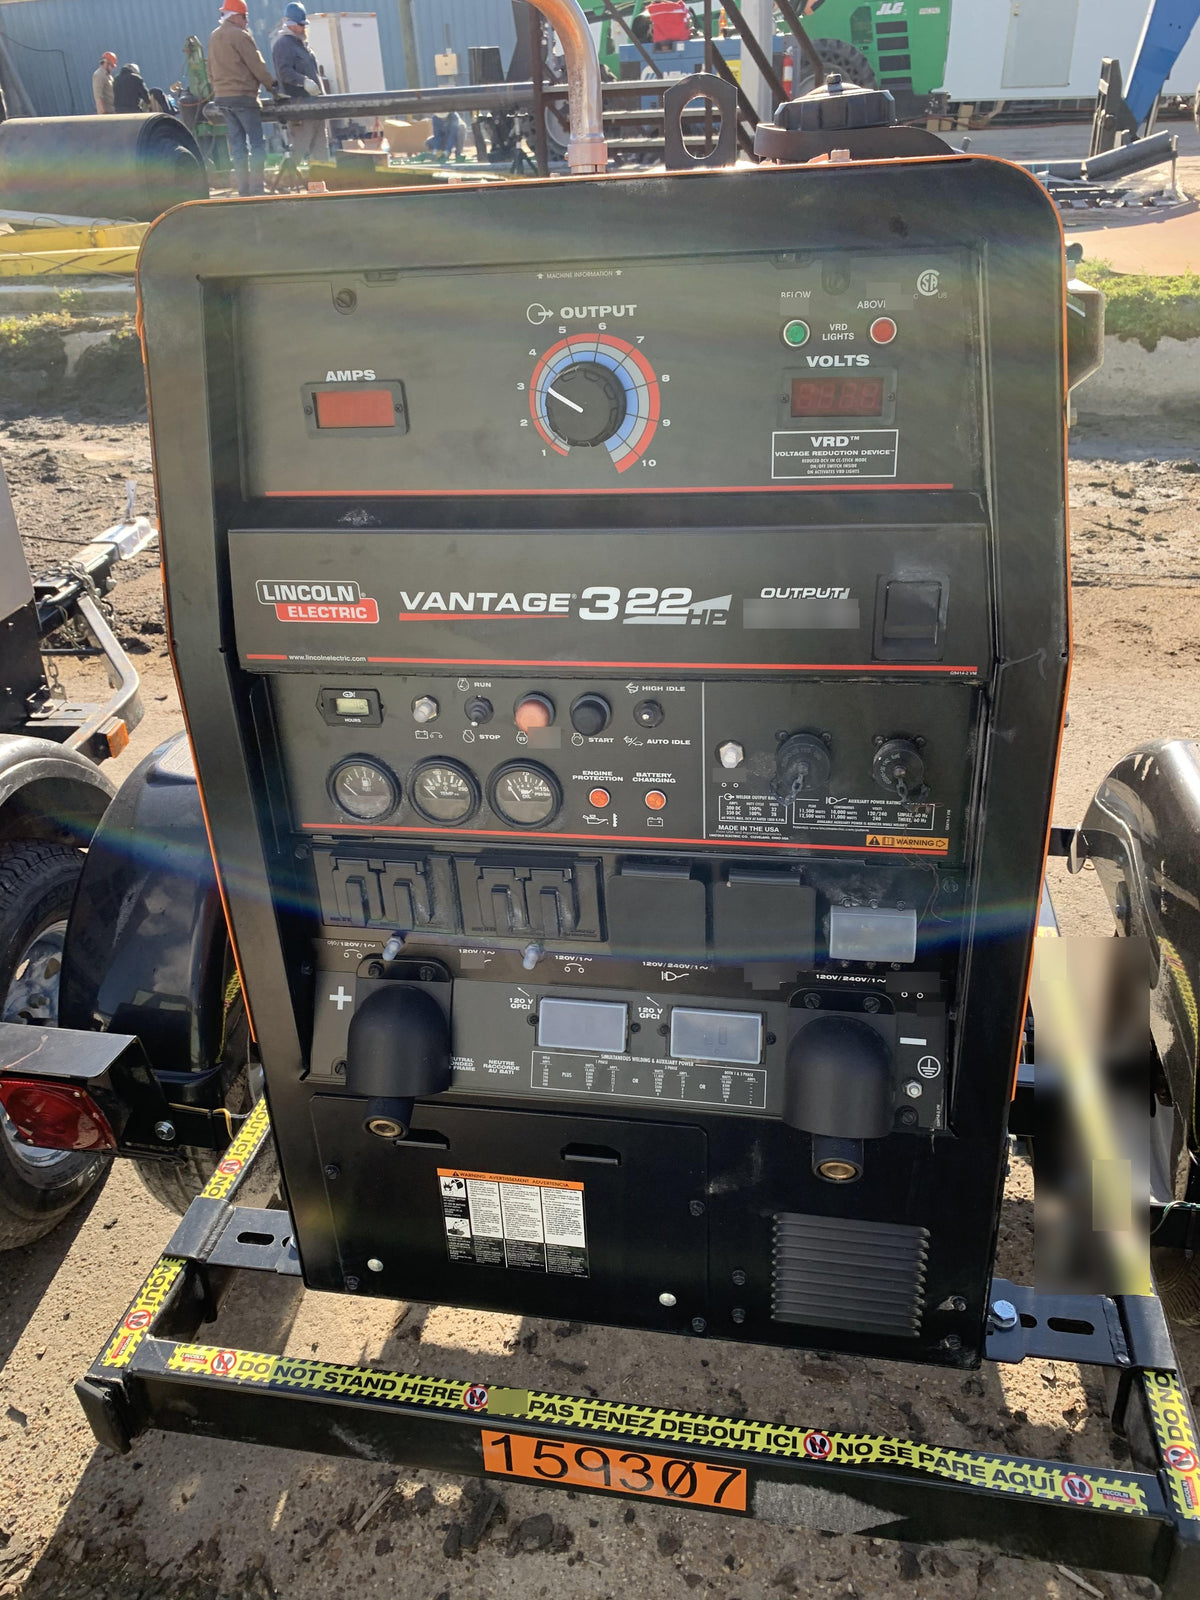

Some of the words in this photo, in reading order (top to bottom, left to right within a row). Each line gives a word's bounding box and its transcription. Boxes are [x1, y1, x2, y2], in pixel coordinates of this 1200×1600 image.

[546, 271, 573, 279] MACHINE
[574, 270, 613, 278] INFORMATION
[857, 299, 886, 310] ABOV
[560, 304, 637, 319] OUTPUT
[558, 325, 567, 334] 5
[598, 322, 607, 331] 6
[829, 323, 848, 331] VRD
[636, 335, 645, 344] 7
[822, 332, 855, 341] LIGHTS
[528, 348, 537, 357] 4
[806, 354, 870, 367] VOLTS
[325, 369, 376, 382] AMPS
[661, 374, 670, 382] 8
[516, 382, 525, 390] 3
[519, 419, 528, 427] 2
[662, 419, 671, 427] 9
[541, 449, 547, 457] 1
[642, 459, 657, 468] 10
[262, 584, 355, 602] LINCOLN
[760, 587, 845, 599] OUTPUT
[287, 605, 368, 619] ELECTRIC
[289, 654, 367, 662] www.lincolnelectric.com
[632, 776, 676, 784] CHARGING
[896, 838, 935, 847] WARNING
[639, 1012, 660, 1020] GFCI
[601, 1054, 631, 1062] SIMULTANEOUS
[460, 1171, 486, 1179] WARNING
[489, 1175, 530, 1184] AVERTISSEMENT
[208, 1176, 228, 1197] NO
[238, 1360, 270, 1375] DO
[273, 1365, 321, 1382] NOT
[323, 1371, 397, 1392] STAND
[401, 1381, 462, 1402] HERE
[528, 1400, 574, 1418] PAS
[579, 1407, 655, 1430] TENEZ
[659, 1417, 761, 1445] DEBOUT
[765, 1434, 798, 1449] ICI
[1164, 1408, 1184, 1442] DO
[490, 1434, 742, 1504] 159307
[836, 1442, 873, 1456] NO
[878, 1444, 912, 1461] SE
[918, 1451, 986, 1480] PARE
[991, 1470, 1057, 1492] AQUÍ
[1098, 1488, 1130, 1499] LINCOLN
